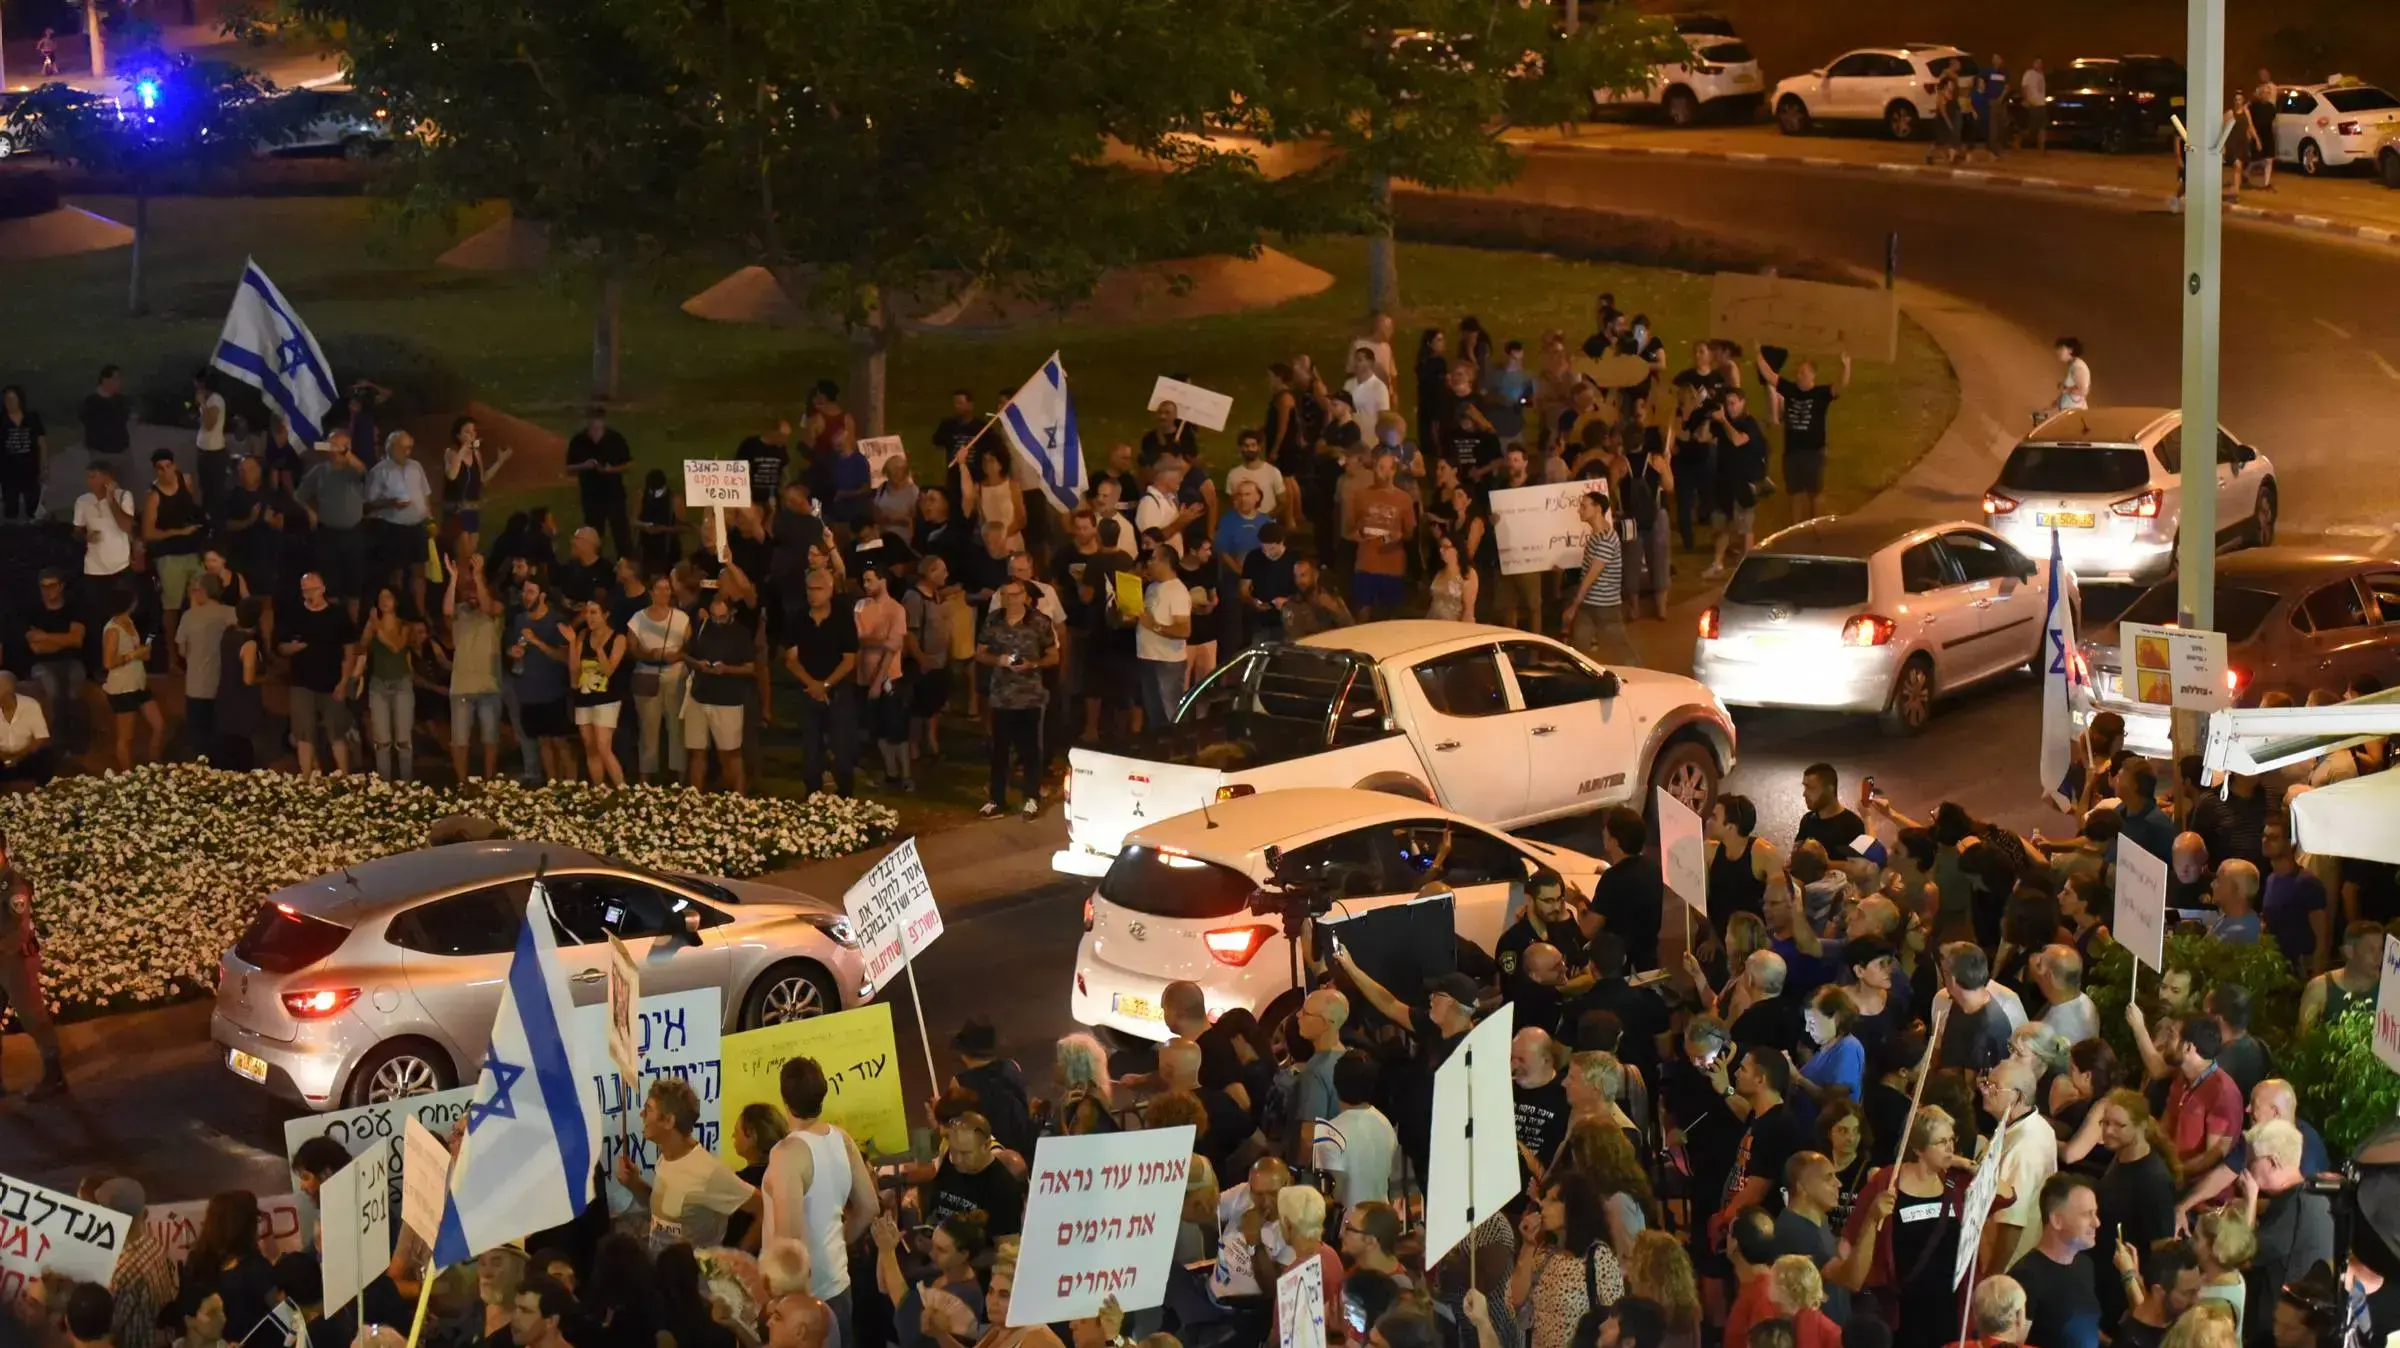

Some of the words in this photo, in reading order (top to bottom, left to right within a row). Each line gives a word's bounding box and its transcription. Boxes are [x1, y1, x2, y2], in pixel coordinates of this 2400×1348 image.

[705, 487, 740, 500] חופשי
[1576, 771, 1626, 796] HUNTER
[868, 843, 914, 888] מנדלבליט
[901, 860, 923, 885] אסר
[872, 877, 901, 909] לחקור
[909, 880, 929, 901] ביבי
[858, 904, 873, 927] את
[854, 913, 888, 949] במקביל
[849, 1053, 886, 1081] עוד
[362, 1157, 386, 1190] אני
[1040, 1167, 1093, 1195] נראה
[1100, 1163, 1132, 1190] עוד
[1138, 1157, 1186, 1186] אנחנו
[0, 1176, 115, 1251] מנדלב
[362, 1190, 386, 1235] 501
[1126, 1212, 1156, 1239] את
[1057, 1215, 1122, 1246] הימים
[1057, 1266, 1137, 1298] האחרים
